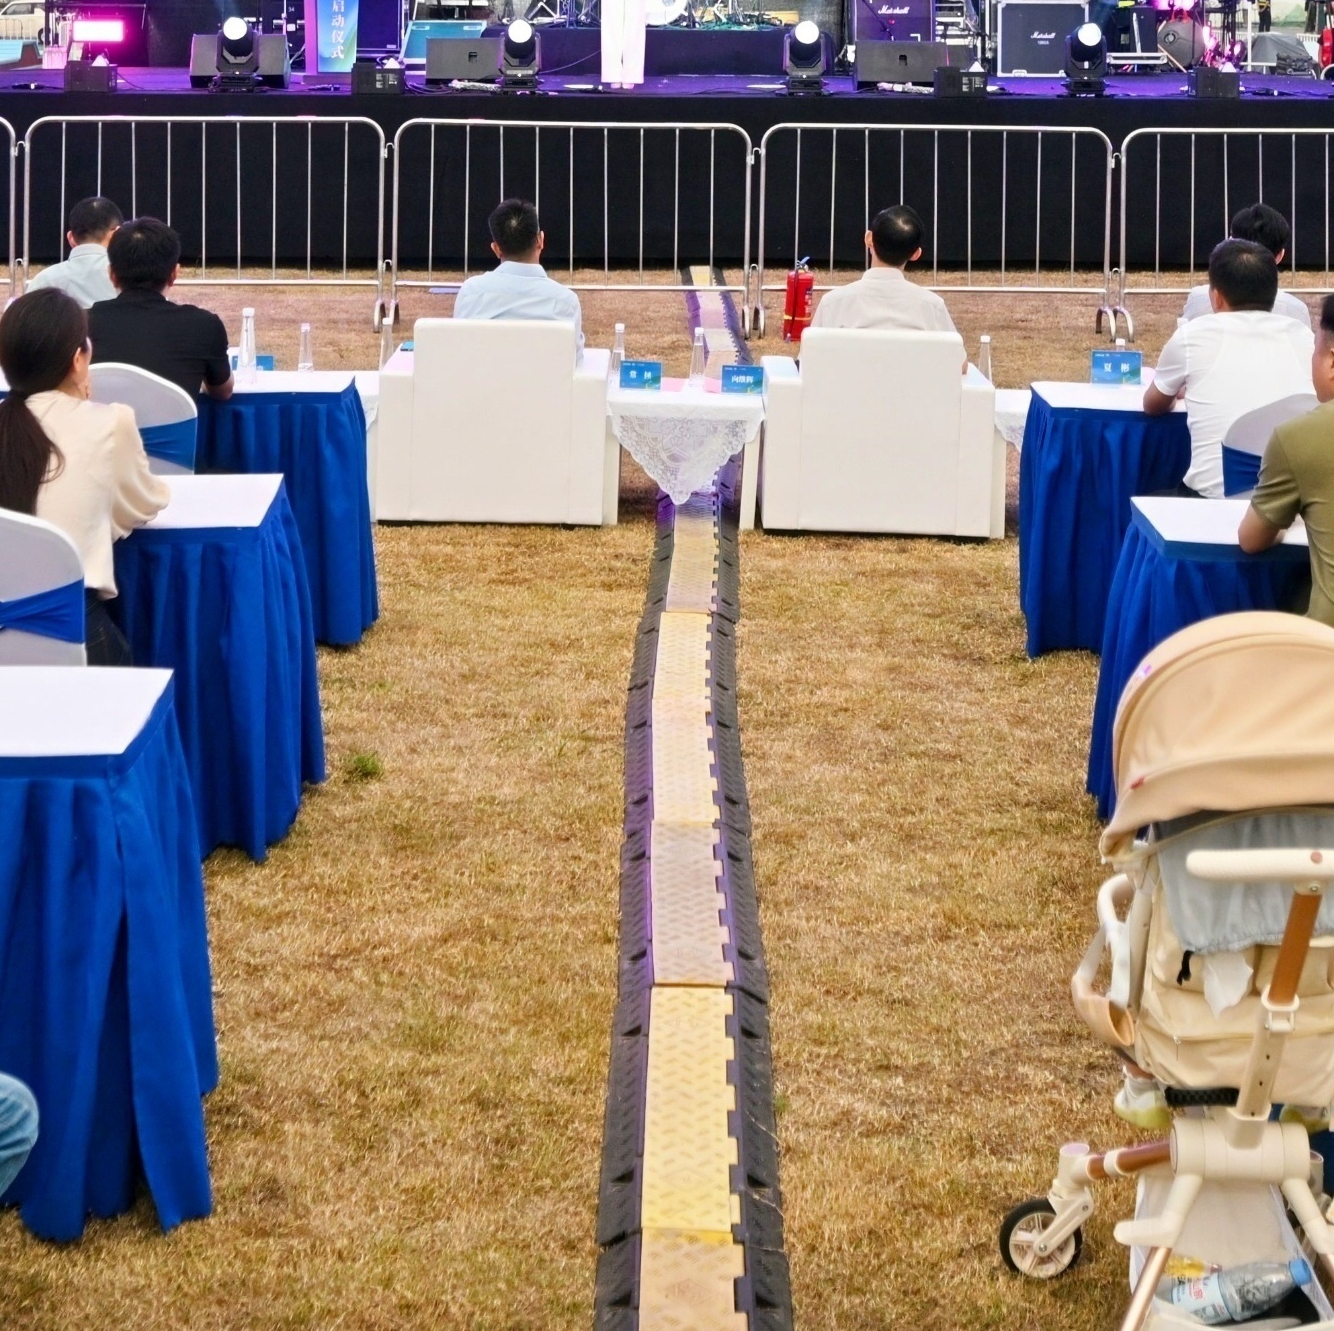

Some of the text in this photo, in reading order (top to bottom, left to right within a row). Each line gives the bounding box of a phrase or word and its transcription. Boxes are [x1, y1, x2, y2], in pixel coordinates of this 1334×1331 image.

[878, 4, 910, 14] Marshall
[331, 0, 345, 59] 启动仪式
